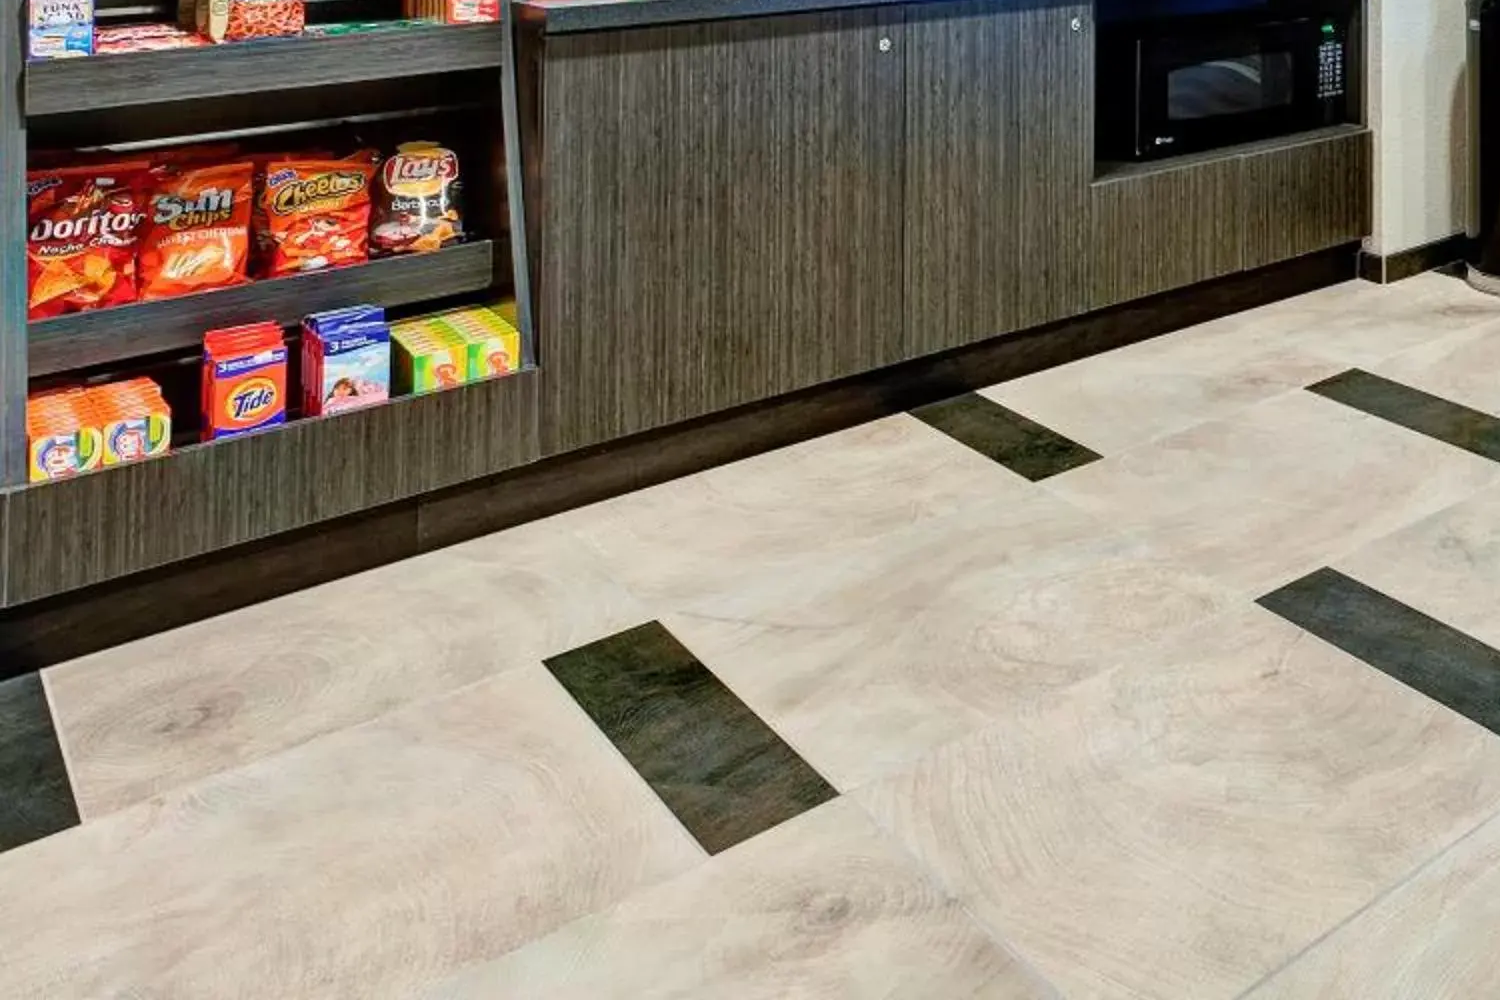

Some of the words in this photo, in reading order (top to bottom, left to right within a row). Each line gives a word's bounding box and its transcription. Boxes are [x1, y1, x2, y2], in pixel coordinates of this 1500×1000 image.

[153, 187, 233, 224] Sun
[31, 209, 147, 241] Doritos
[233, 387, 275, 420] Tide
